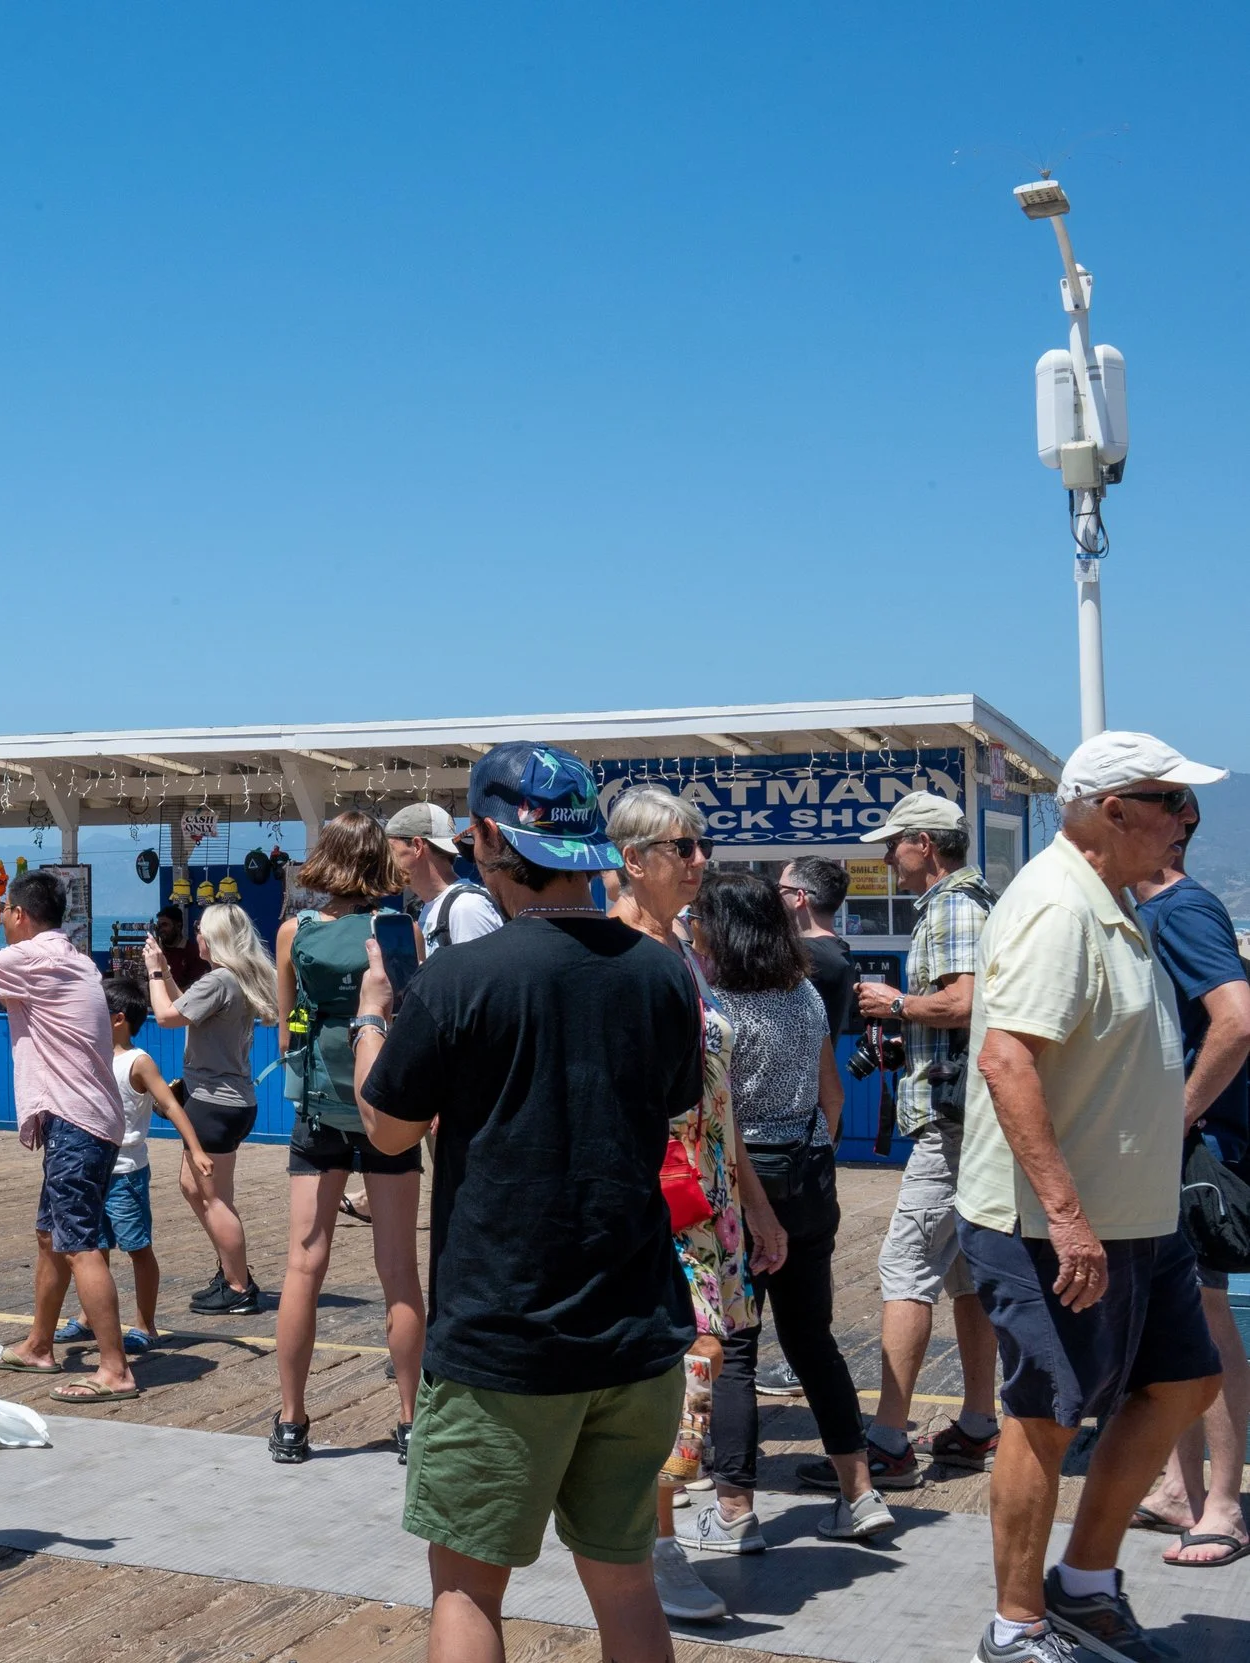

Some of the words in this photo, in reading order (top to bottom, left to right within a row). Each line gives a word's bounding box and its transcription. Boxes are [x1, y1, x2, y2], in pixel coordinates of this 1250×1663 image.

[185, 815, 214, 824] CASH
[707, 809, 775, 829] CK
[789, 808, 890, 828] SHO
[185, 824, 214, 832] ONLY
[850, 866, 879, 874] SMILE
